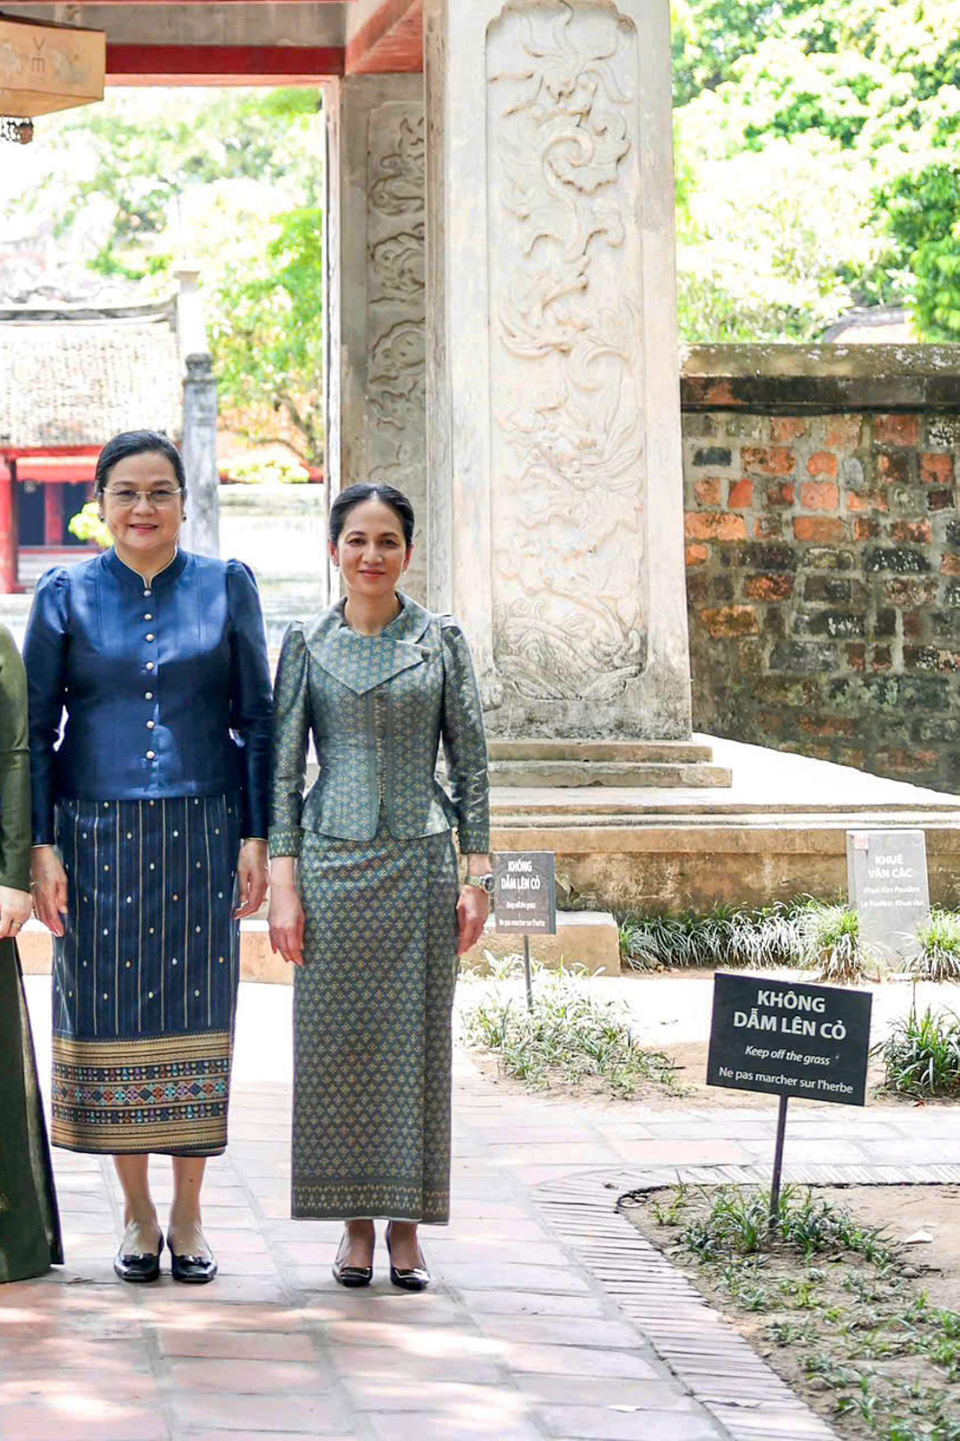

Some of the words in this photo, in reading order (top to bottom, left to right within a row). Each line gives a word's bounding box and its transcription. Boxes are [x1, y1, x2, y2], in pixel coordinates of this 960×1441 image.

[757, 989, 826, 1013] KHÔNG
[733, 1008, 777, 1032] DẪM
[781, 1015, 816, 1037] LÊN
[820, 1020, 847, 1040] CỎ
[745, 1045, 770, 1059] Keep
[770, 1049, 786, 1059] off
[786, 1051, 803, 1062] the
[803, 1054, 831, 1066] grass
[719, 1067, 733, 1078] Ne
[735, 1069, 753, 1081] pas
[755, 1071, 798, 1087] marcher
[799, 1079, 816, 1089] sur
[817, 1079, 854, 1094] l'herbe
